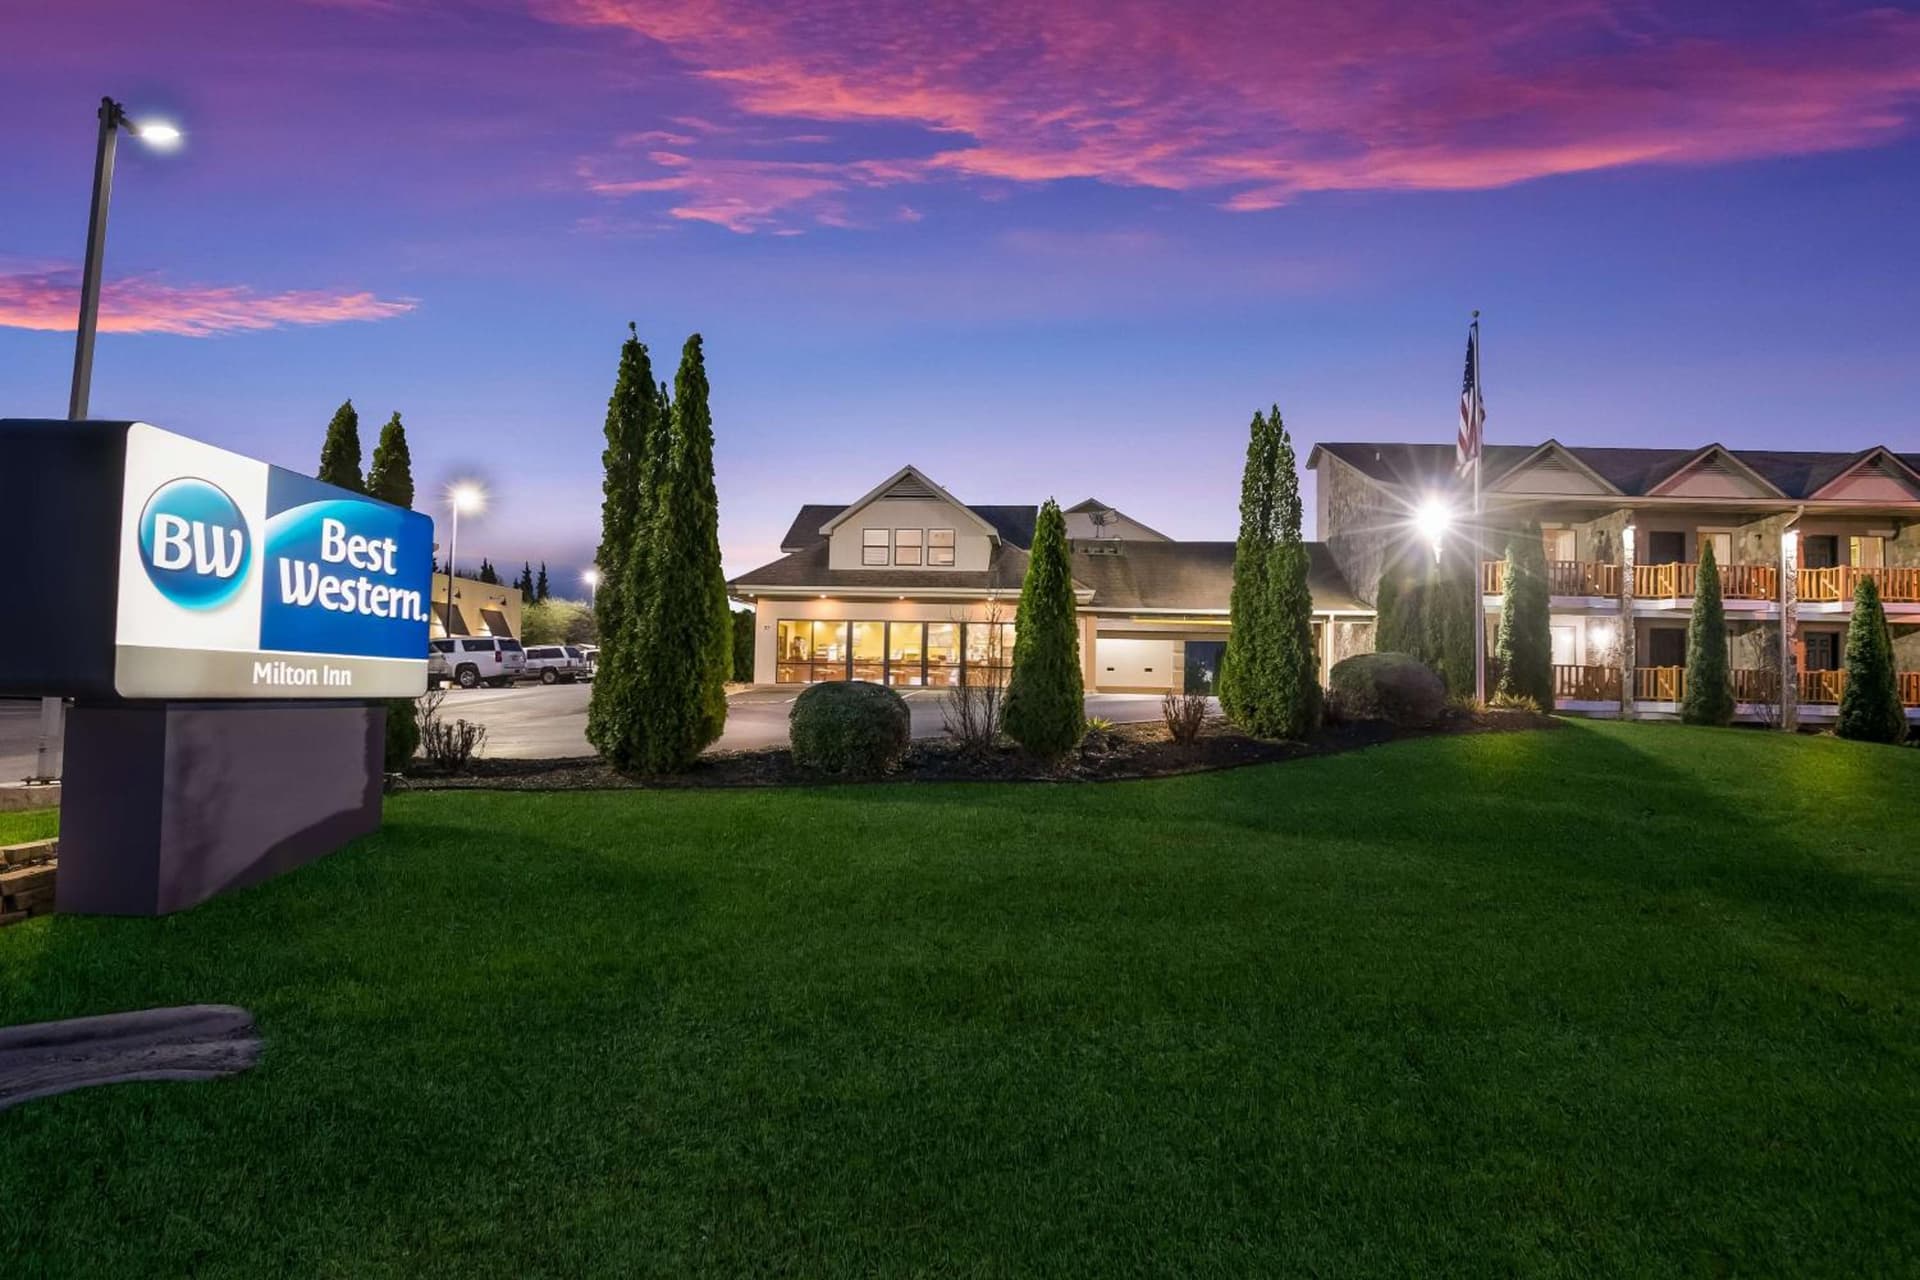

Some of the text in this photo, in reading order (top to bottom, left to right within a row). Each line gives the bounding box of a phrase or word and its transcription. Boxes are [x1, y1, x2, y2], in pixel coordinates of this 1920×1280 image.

[152, 513, 244, 578] BW
[321, 518, 398, 575] Best
[252, 661, 352, 687] Milton Inn
